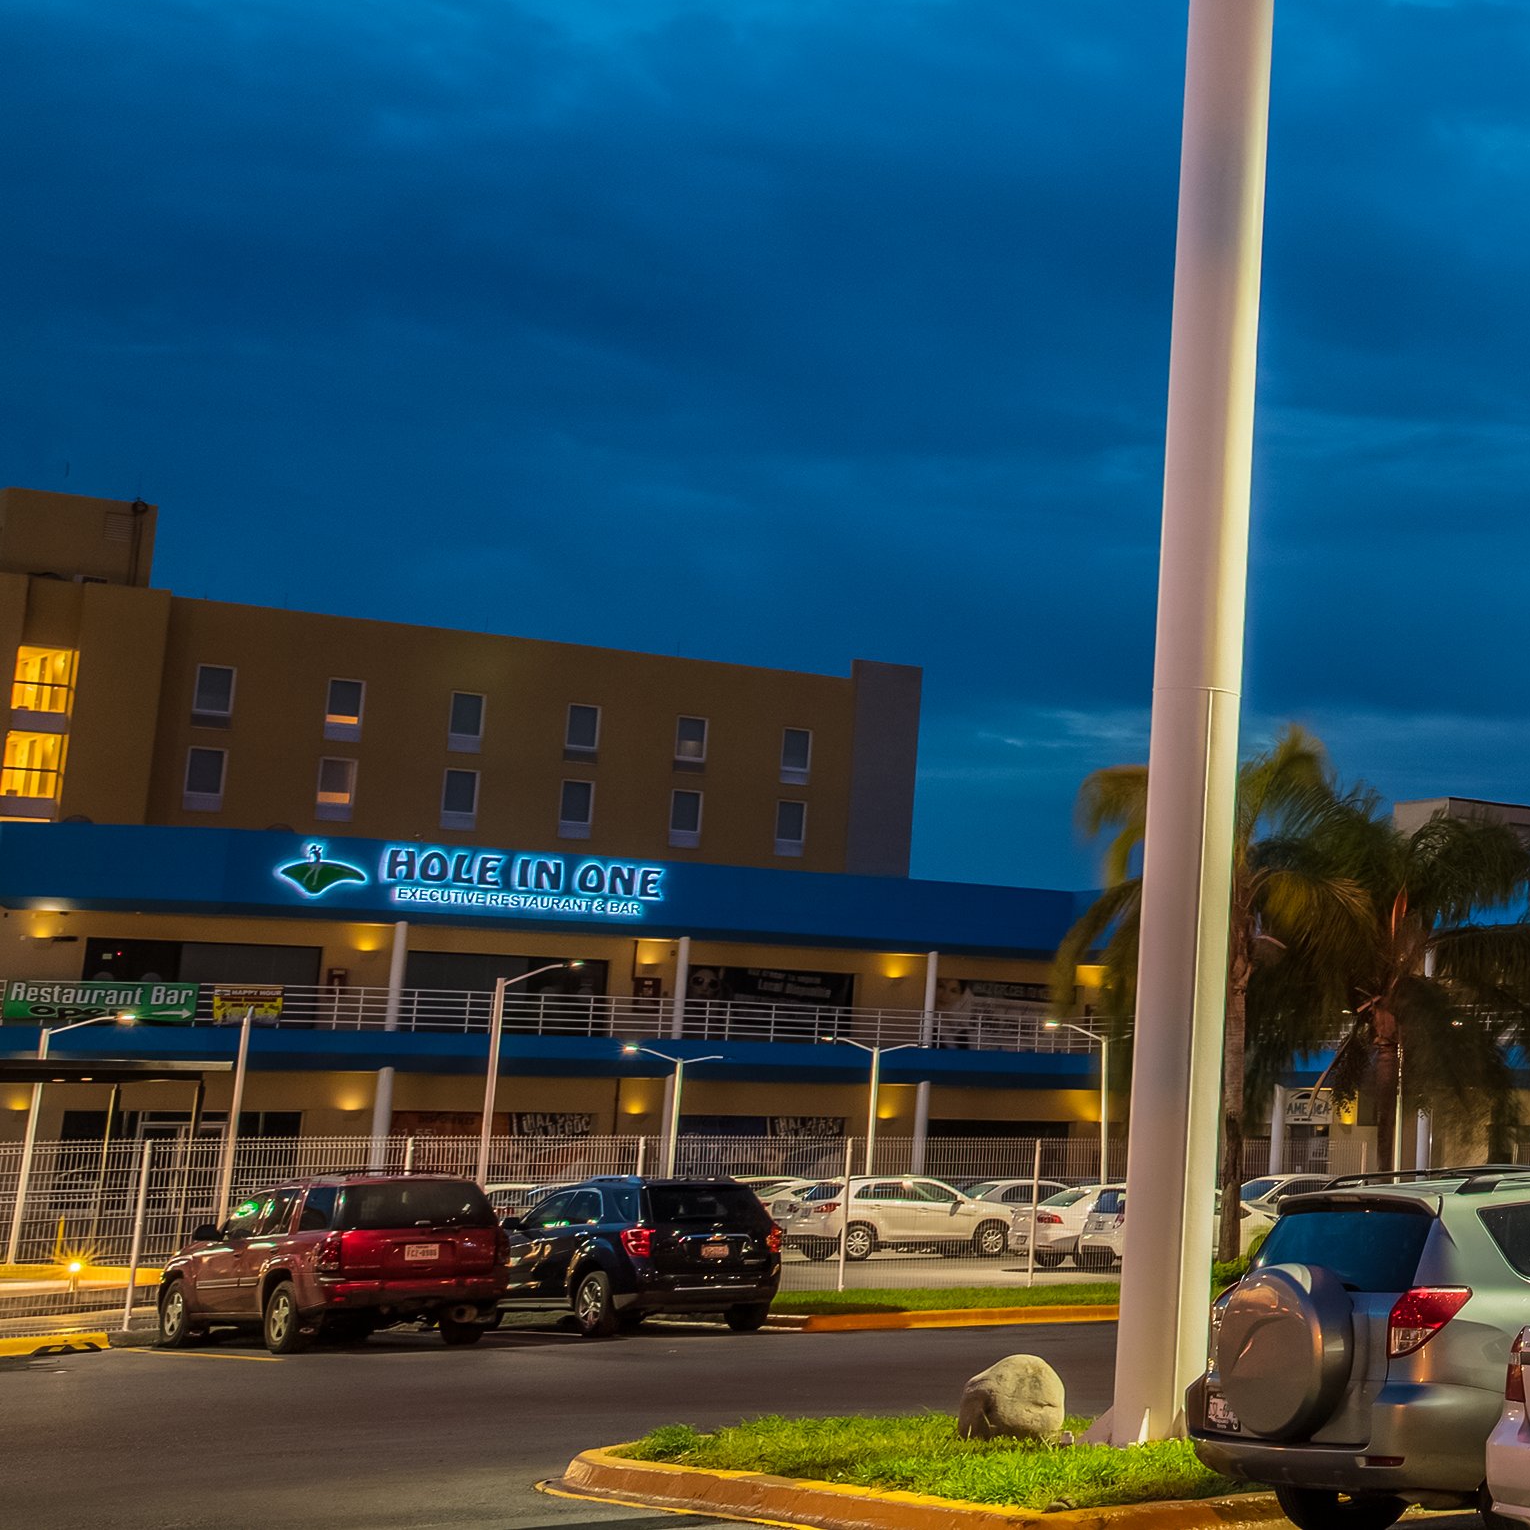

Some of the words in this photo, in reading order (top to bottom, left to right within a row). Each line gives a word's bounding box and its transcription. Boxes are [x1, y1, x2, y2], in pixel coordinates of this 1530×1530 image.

[386, 848, 503, 889] HOLE
[517, 858, 563, 891] IN
[578, 864, 664, 901] ONE
[396, 888, 485, 905] EXECUTIVE
[489, 893, 592, 913] RESTAURANT
[594, 899, 606, 912] &
[609, 902, 641, 915] BAR
[10, 982, 144, 1005] Restaurant
[150, 985, 194, 1005] Bar
